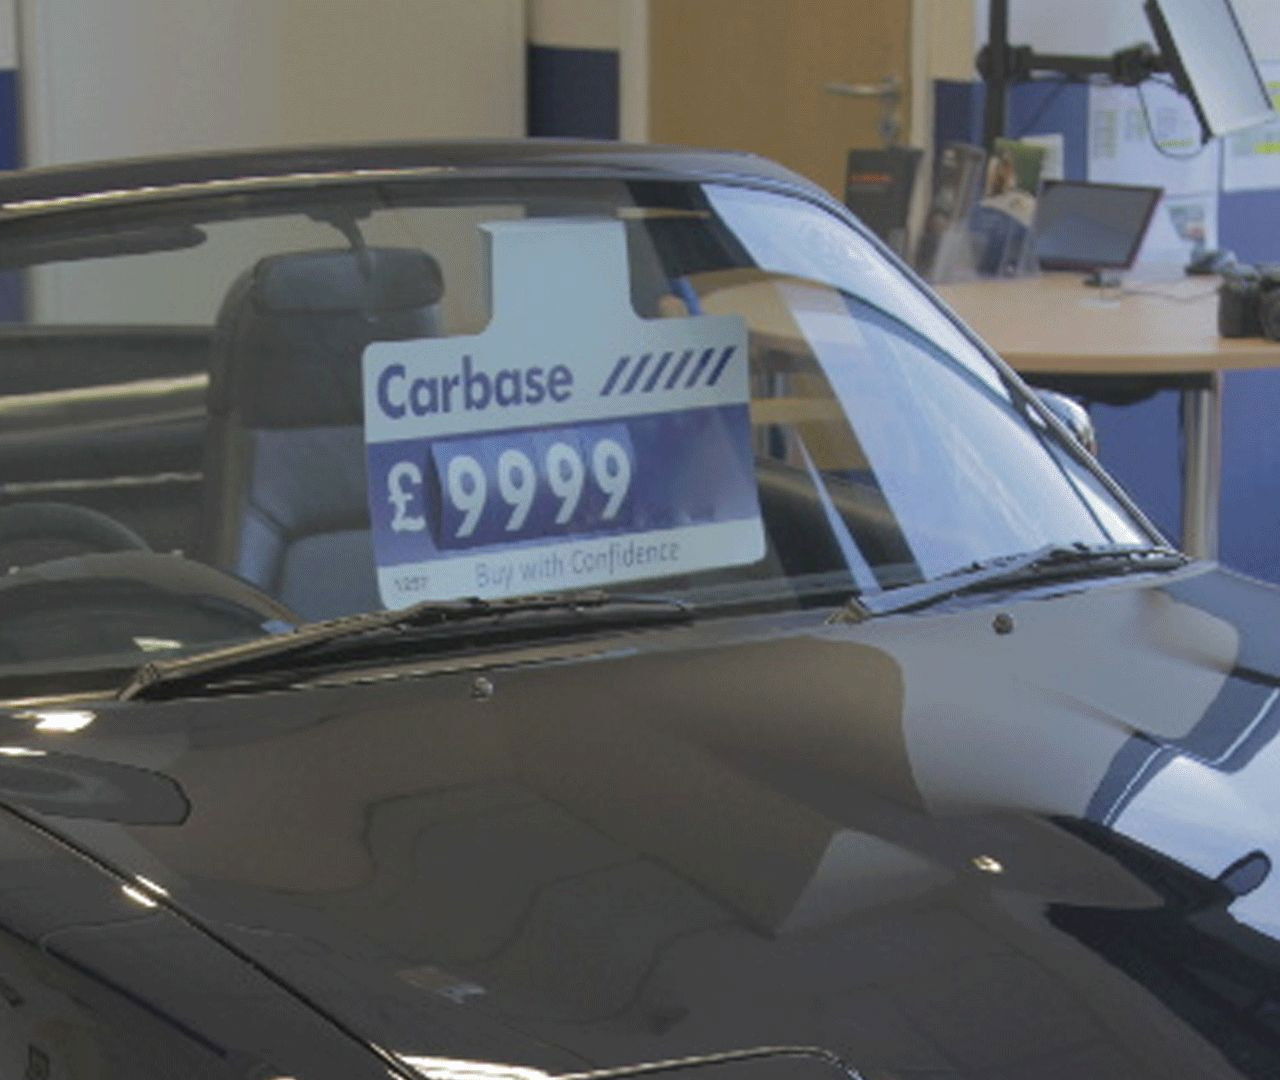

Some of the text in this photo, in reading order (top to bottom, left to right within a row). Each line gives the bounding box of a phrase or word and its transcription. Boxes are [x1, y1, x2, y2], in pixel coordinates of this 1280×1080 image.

[376, 356, 574, 419] Carbase
[475, 540, 681, 589] Buy with Confidence
